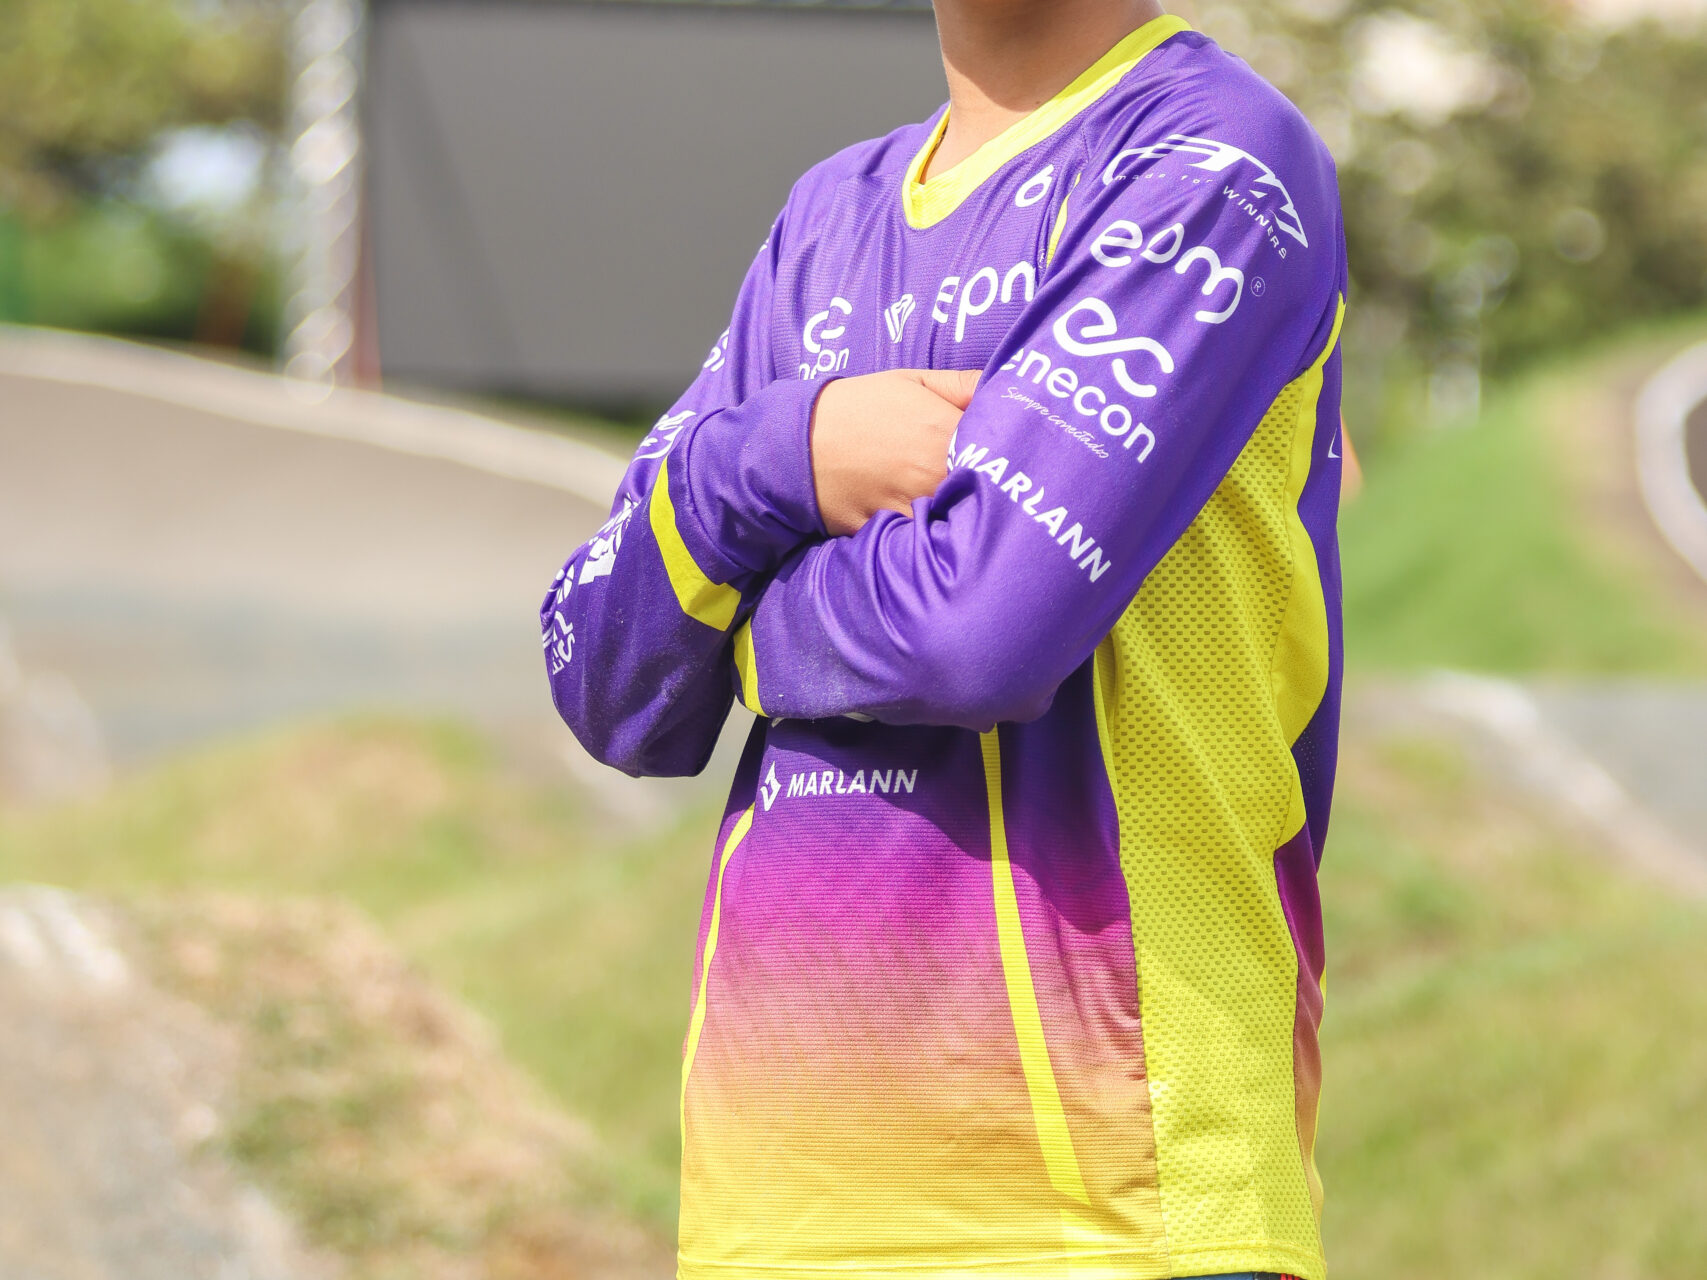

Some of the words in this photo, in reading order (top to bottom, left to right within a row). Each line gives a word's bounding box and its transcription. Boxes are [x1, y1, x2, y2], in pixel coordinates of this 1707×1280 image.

[1222, 185, 1288, 260] WINNERS
[954, 442, 1112, 583] MARLANN
[786, 769, 919, 800] MARLANN
